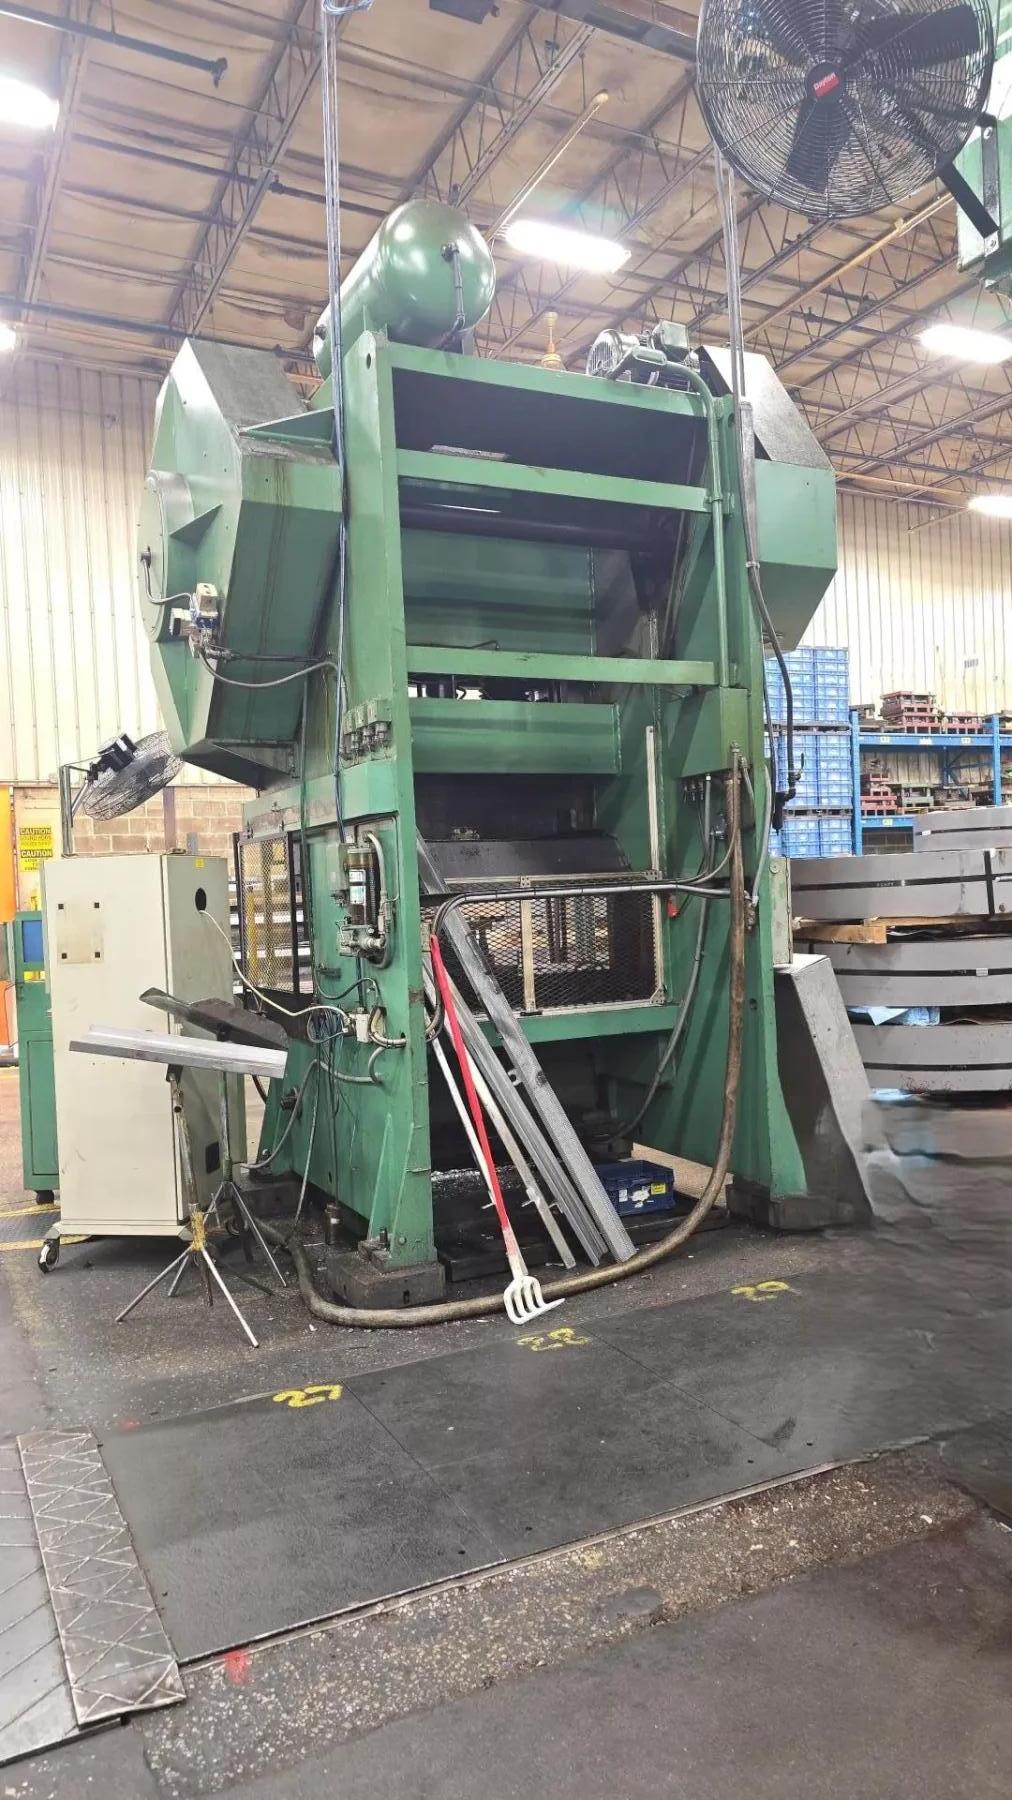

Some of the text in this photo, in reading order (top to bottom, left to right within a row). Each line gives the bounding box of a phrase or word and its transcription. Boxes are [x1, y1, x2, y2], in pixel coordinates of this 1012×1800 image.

[20, 827, 51, 835] CAUTION
[21, 850, 52, 858] CAUTION
[272, 1384, 343, 1407] 27
